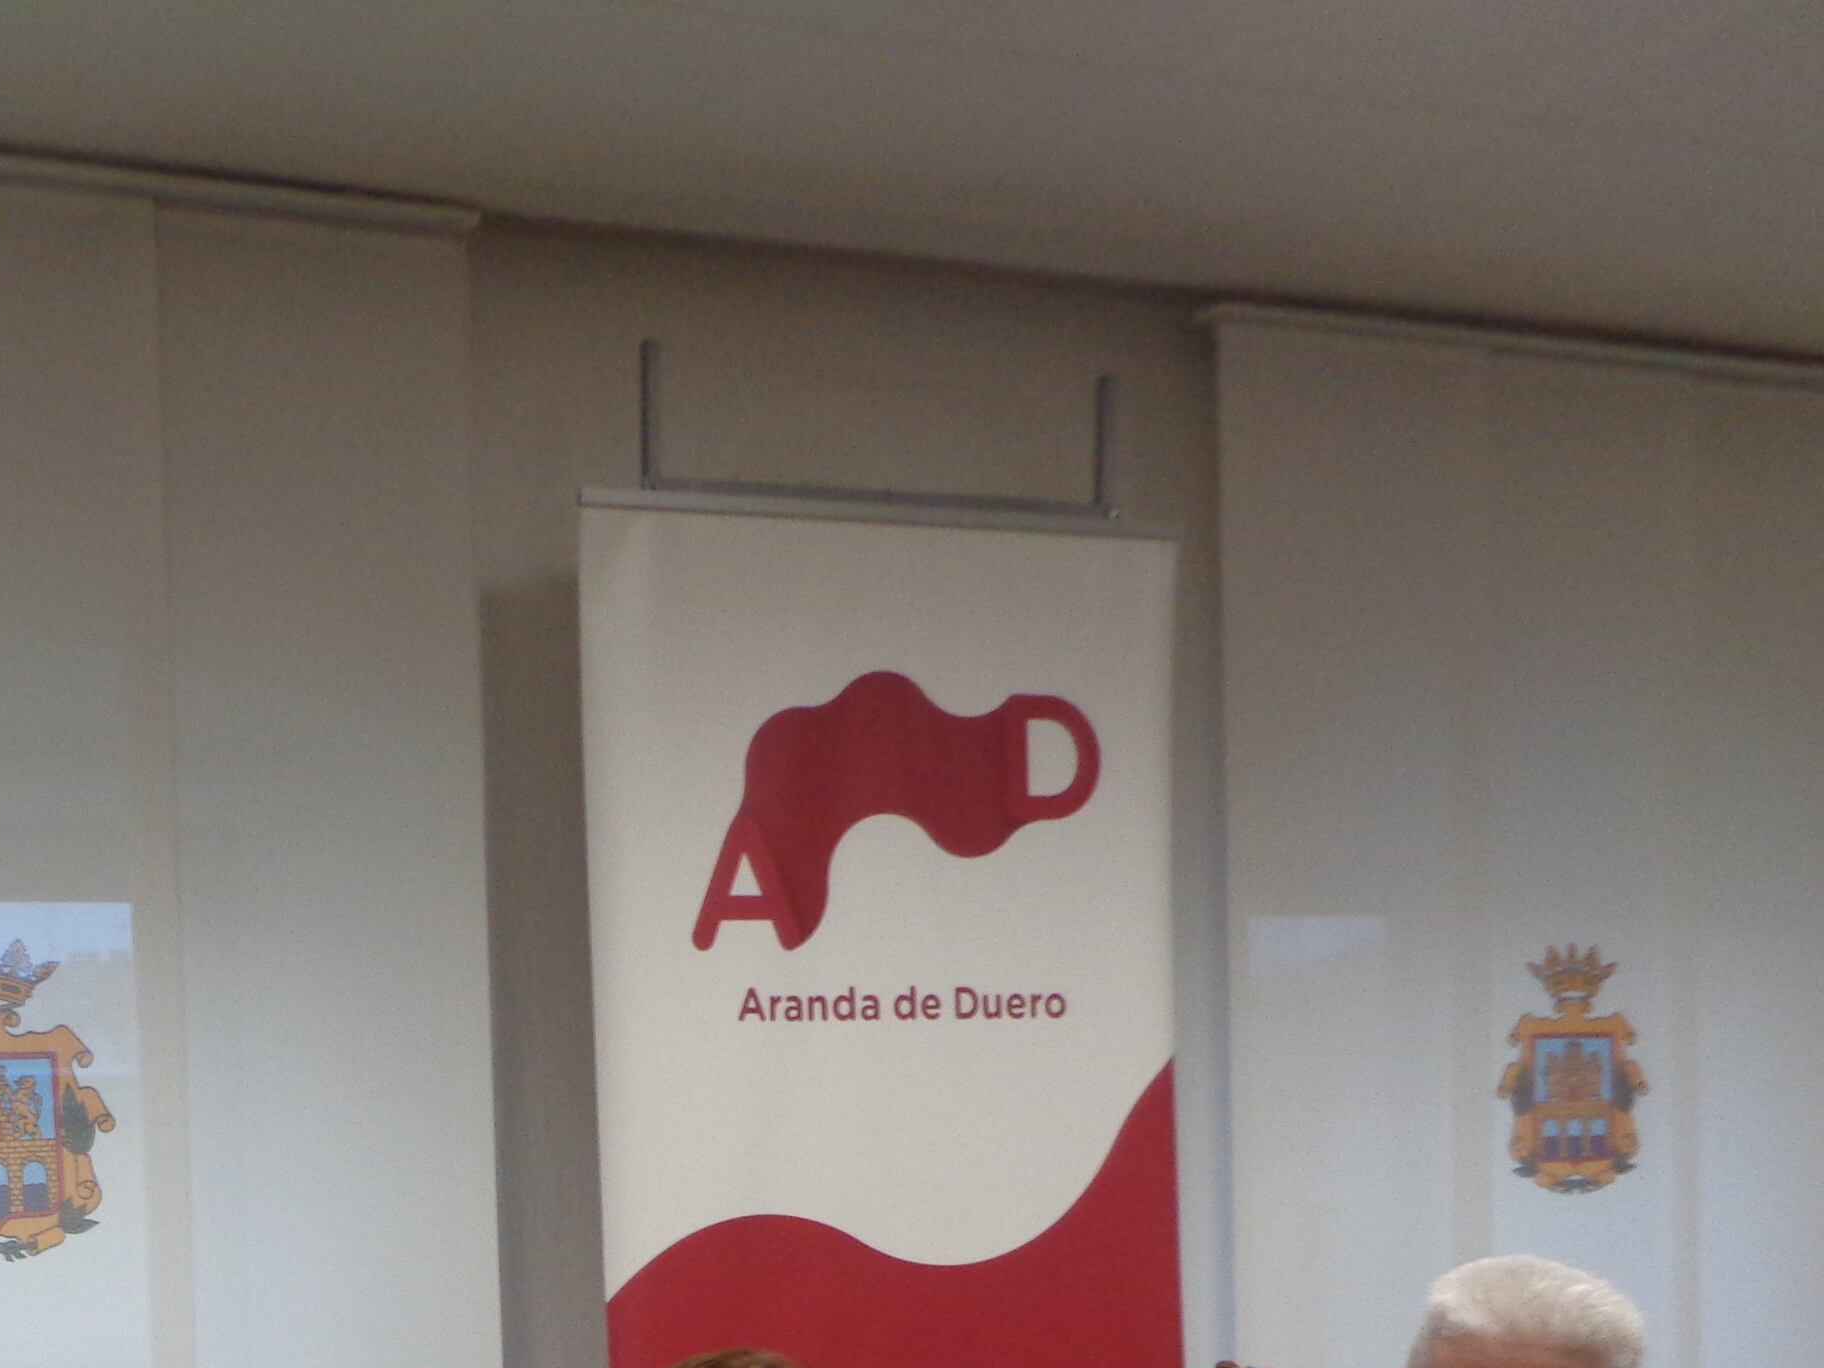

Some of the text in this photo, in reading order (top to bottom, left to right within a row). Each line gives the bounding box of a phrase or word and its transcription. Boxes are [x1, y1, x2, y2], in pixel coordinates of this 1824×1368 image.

[738, 985, 1067, 1022] Aranda de Duero
